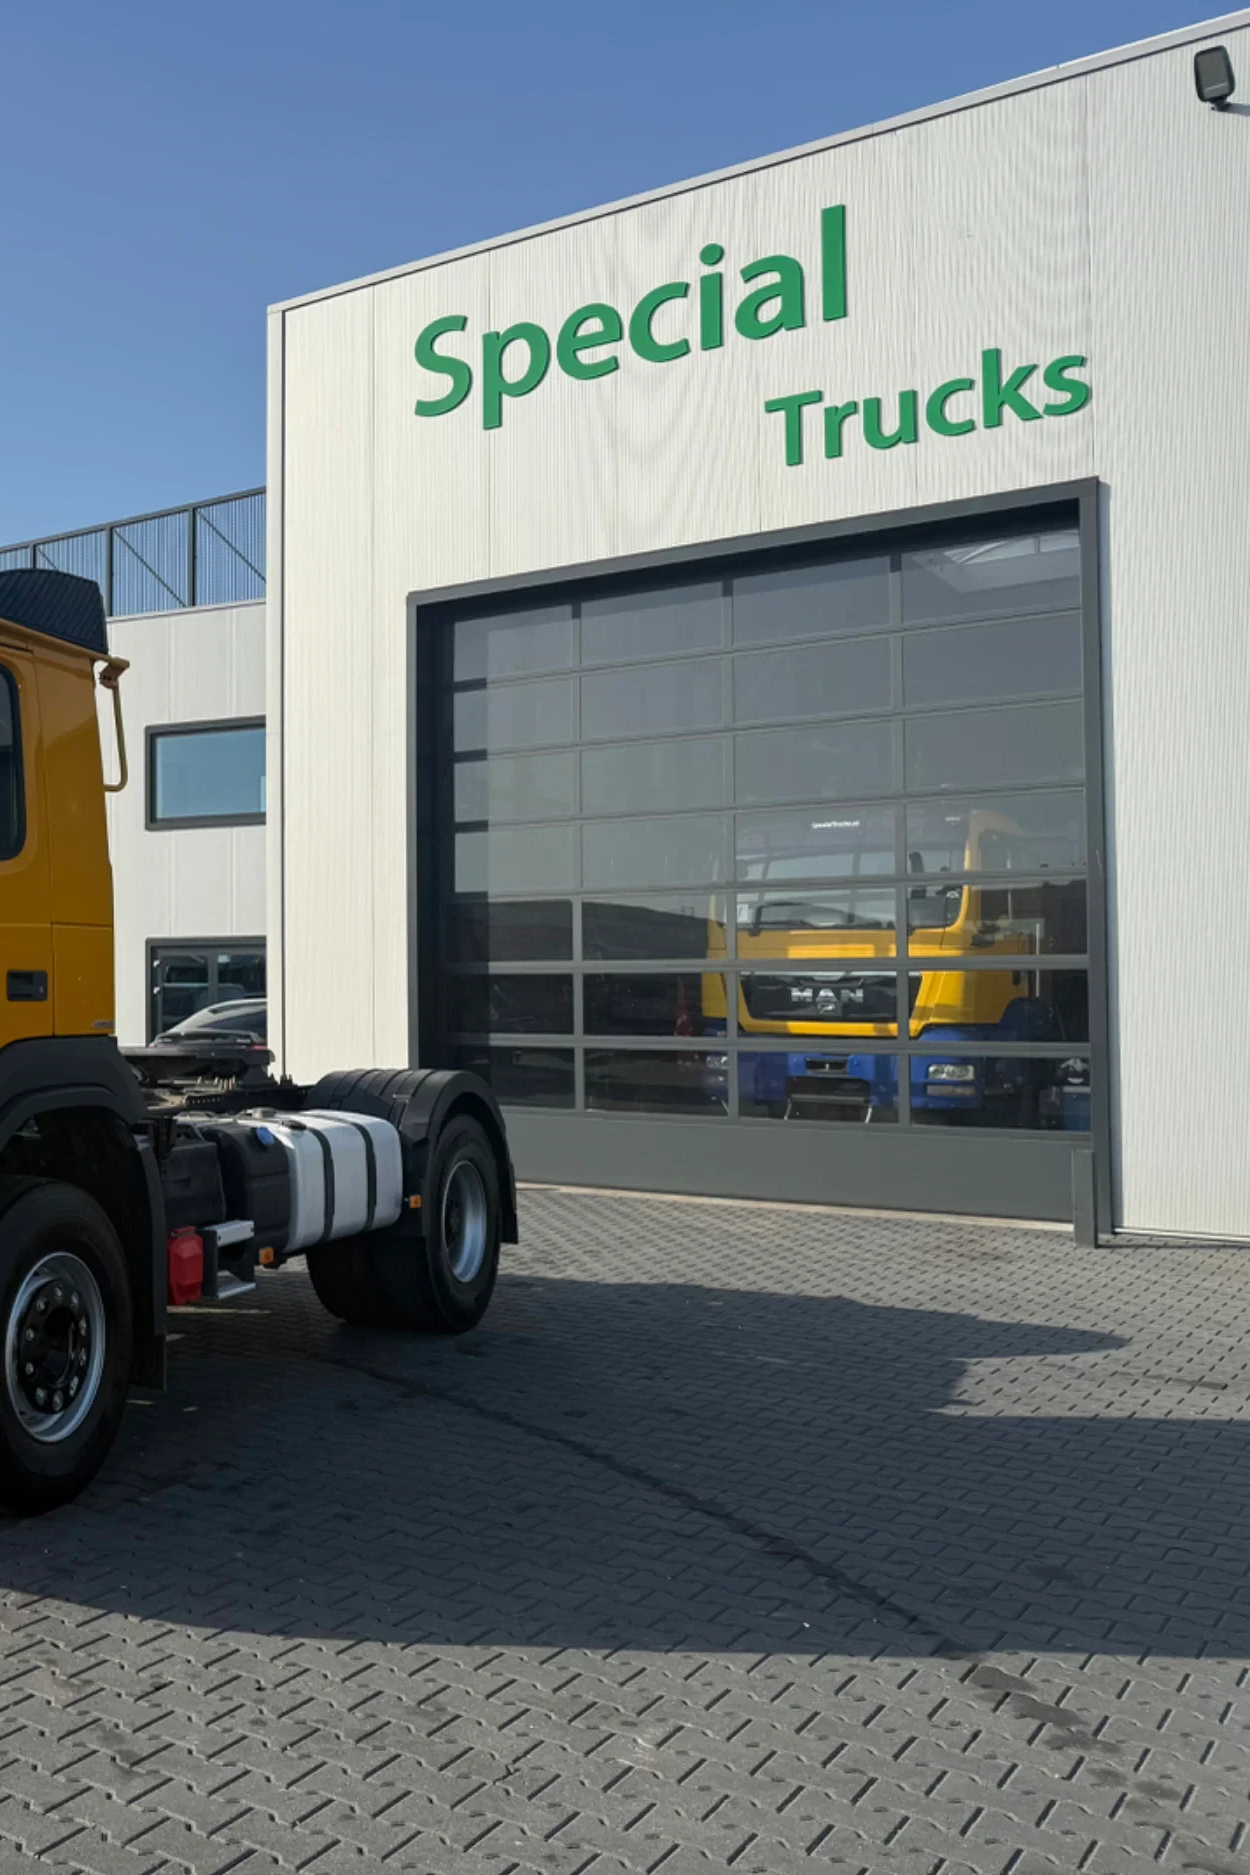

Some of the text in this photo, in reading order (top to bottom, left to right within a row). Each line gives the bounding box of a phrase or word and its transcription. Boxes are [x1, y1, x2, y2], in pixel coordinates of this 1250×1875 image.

[414, 204, 848, 430] Special
[764, 348, 1092, 466] Trucks
[790, 987, 864, 1003] MAN
